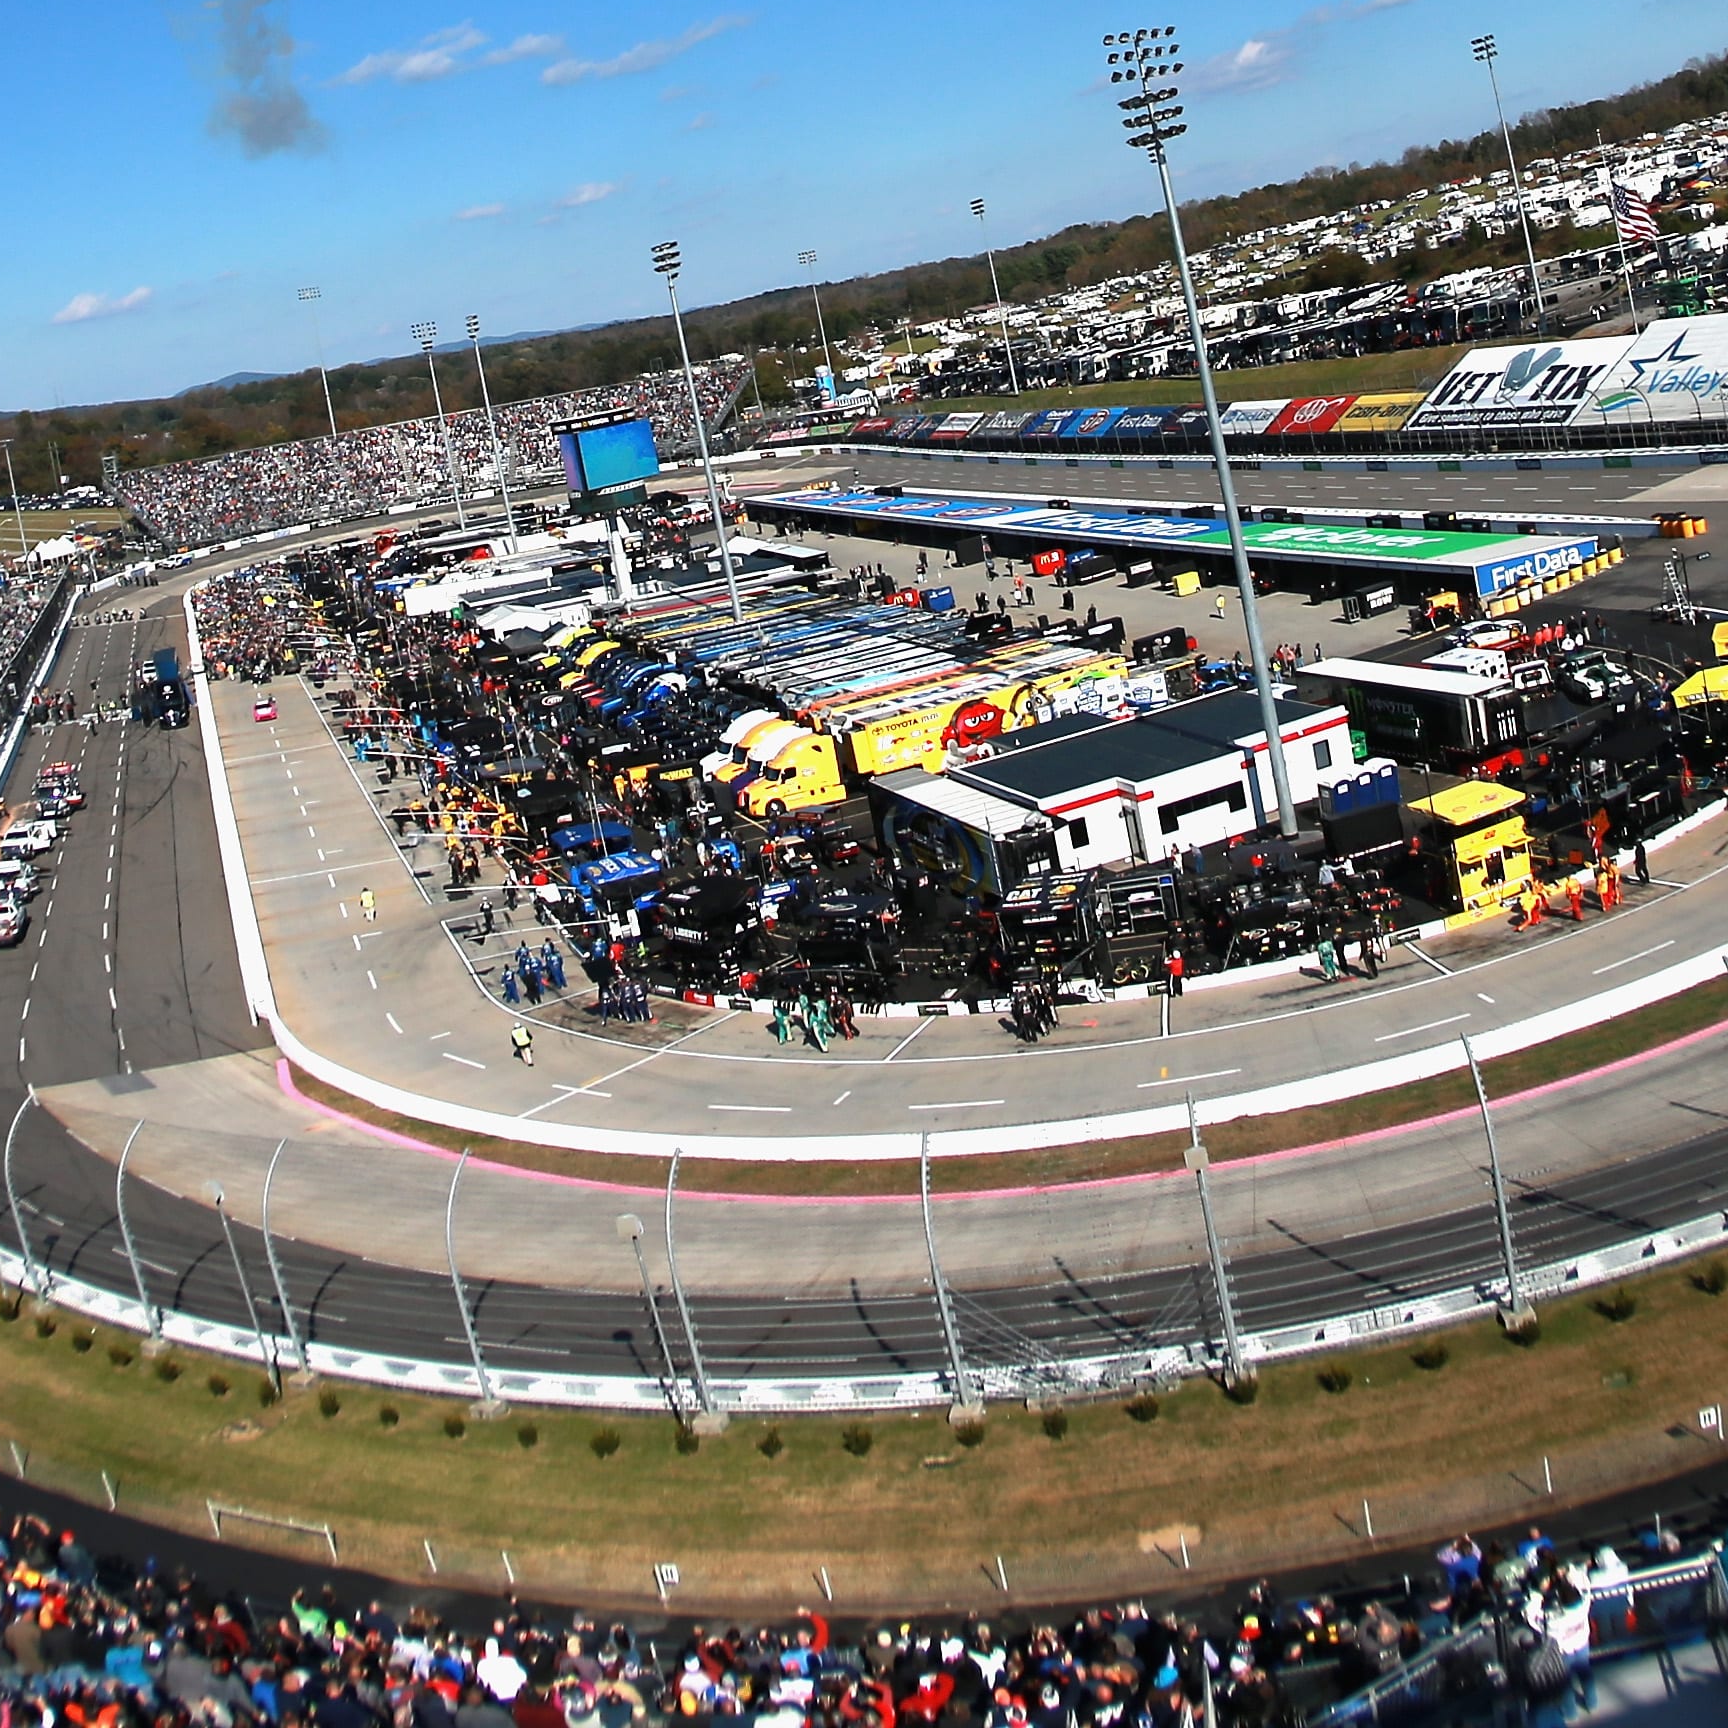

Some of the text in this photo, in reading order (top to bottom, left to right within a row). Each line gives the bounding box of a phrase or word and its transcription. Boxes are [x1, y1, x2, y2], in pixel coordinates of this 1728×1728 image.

[1433, 363, 1608, 407] VET TIX
[1082, 412, 1106, 432] STP
[1115, 414, 1141, 428] First
[1134, 413, 1163, 428] Data
[1491, 542, 1580, 591] First Data
[885, 718, 919, 732] TOYOTA
[1006, 888, 1043, 902] CAT
[674, 926, 703, 941] LIBERTY
